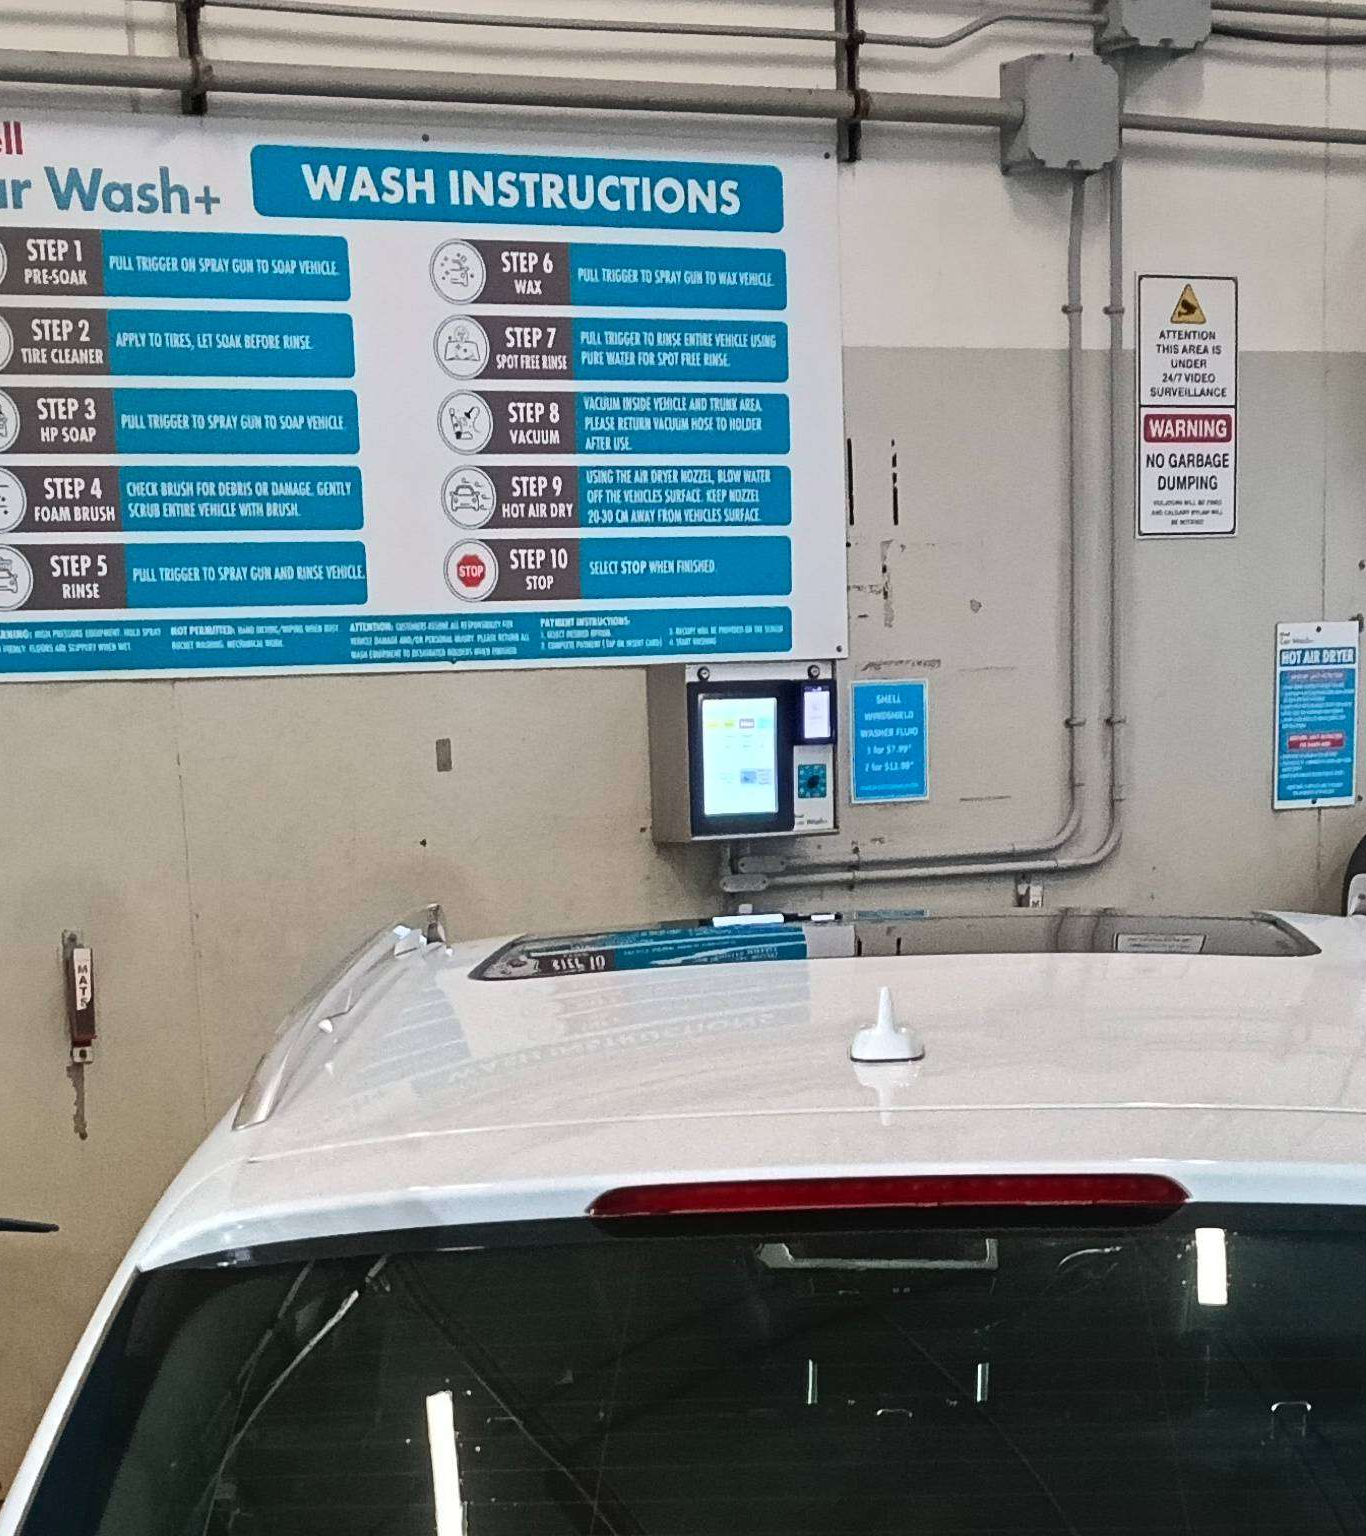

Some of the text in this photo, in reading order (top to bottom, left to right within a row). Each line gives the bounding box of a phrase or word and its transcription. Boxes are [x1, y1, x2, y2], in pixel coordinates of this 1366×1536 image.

[45, 166, 220, 215] Wash+
[302, 164, 739, 214] WASH INSTRUCTIONS
[26, 240, 81, 261] STEP 1
[109, 256, 133, 270] PULL
[136, 256, 178, 271] TRIGGER
[180, 257, 195, 271] ON
[198, 258, 228, 272] SPRAY
[232, 258, 253, 273] GUN
[257, 259, 268, 273] TO
[271, 259, 296, 274] SOAP
[501, 252, 553, 273] STEP 6
[24, 269, 87, 284] PRE-SOAK
[577, 268, 598, 281] PULL
[602, 268, 638, 282] TRIGGER
[641, 269, 652, 283] TO
[654, 270, 681, 283] SPRAY
[683, 271, 702, 284] GUN
[705, 271, 716, 284] TO
[718, 272, 736, 284] WAX
[514, 279, 541, 294] WAX
[31, 319, 89, 341] STEP 2
[1159, 330, 1215, 339] ATTENTION
[116, 332, 145, 346] APPLY
[149, 333, 162, 346] TO
[197, 333, 212, 347] LET
[216, 334, 241, 348] SOAK
[244, 334, 279, 348] BEFORE
[505, 328, 556, 348] STEP 7
[21, 348, 103, 364] TIRE CLEANER
[1156, 344, 1221, 354] THIS AREA IS
[496, 354, 566, 369] SPOT FREE RINSE
[1171, 359, 1206, 368] UNDER
[1162, 373, 1215, 382] 24/7 VIDEO
[1150, 387, 1227, 396] SURVEILLANCE
[37, 398, 95, 419] STEP 3
[508, 402, 559, 422] STEP 8
[121, 414, 304, 429] PULL TRIGGER TO SPRAY GUN TO SOAP
[1149, 419, 1226, 437] WARNING
[40, 427, 96, 442] HP SOAP
[509, 429, 559, 443] VACUUM
[1146, 453, 1229, 467] NO GARBAGE
[44, 478, 102, 498] STEP 4
[126, 482, 158, 496] CHECK
[160, 482, 193, 496] BRUSH
[196, 482, 215, 495] FOR
[218, 482, 252, 495] DEBRIS
[254, 482, 268, 495] OR
[316, 482, 350, 495] GENTLY
[511, 476, 562, 496] STEP 9
[1157, 476, 1217, 490] DUMPING
[34, 506, 115, 521] FOAM BRUSH
[128, 503, 160, 517] SCRUB
[162, 503, 195, 516] ENTIRE
[198, 503, 235, 516] VEHICLE
[238, 503, 263, 515] WITH
[502, 503, 572, 517] HOT AIR DRY
[50, 555, 107, 576] STEP 5
[510, 548, 567, 568] STEP 10
[132, 568, 155, 581] PULL
[159, 567, 199, 581] TRIGGER
[203, 566, 215, 580] TO
[217, 566, 247, 580] SPRAY
[250, 566, 271, 580] GUN
[274, 566, 294, 579] AND
[296, 565, 322, 579] RINSE
[459, 565, 484, 577] STOP
[589, 560, 674, 574] SELECT STOP WHEN
[526, 575, 553, 589] STOP
[62, 583, 99, 598] RINSE
[1281, 648, 1354, 665] HOT AIR DRYER
